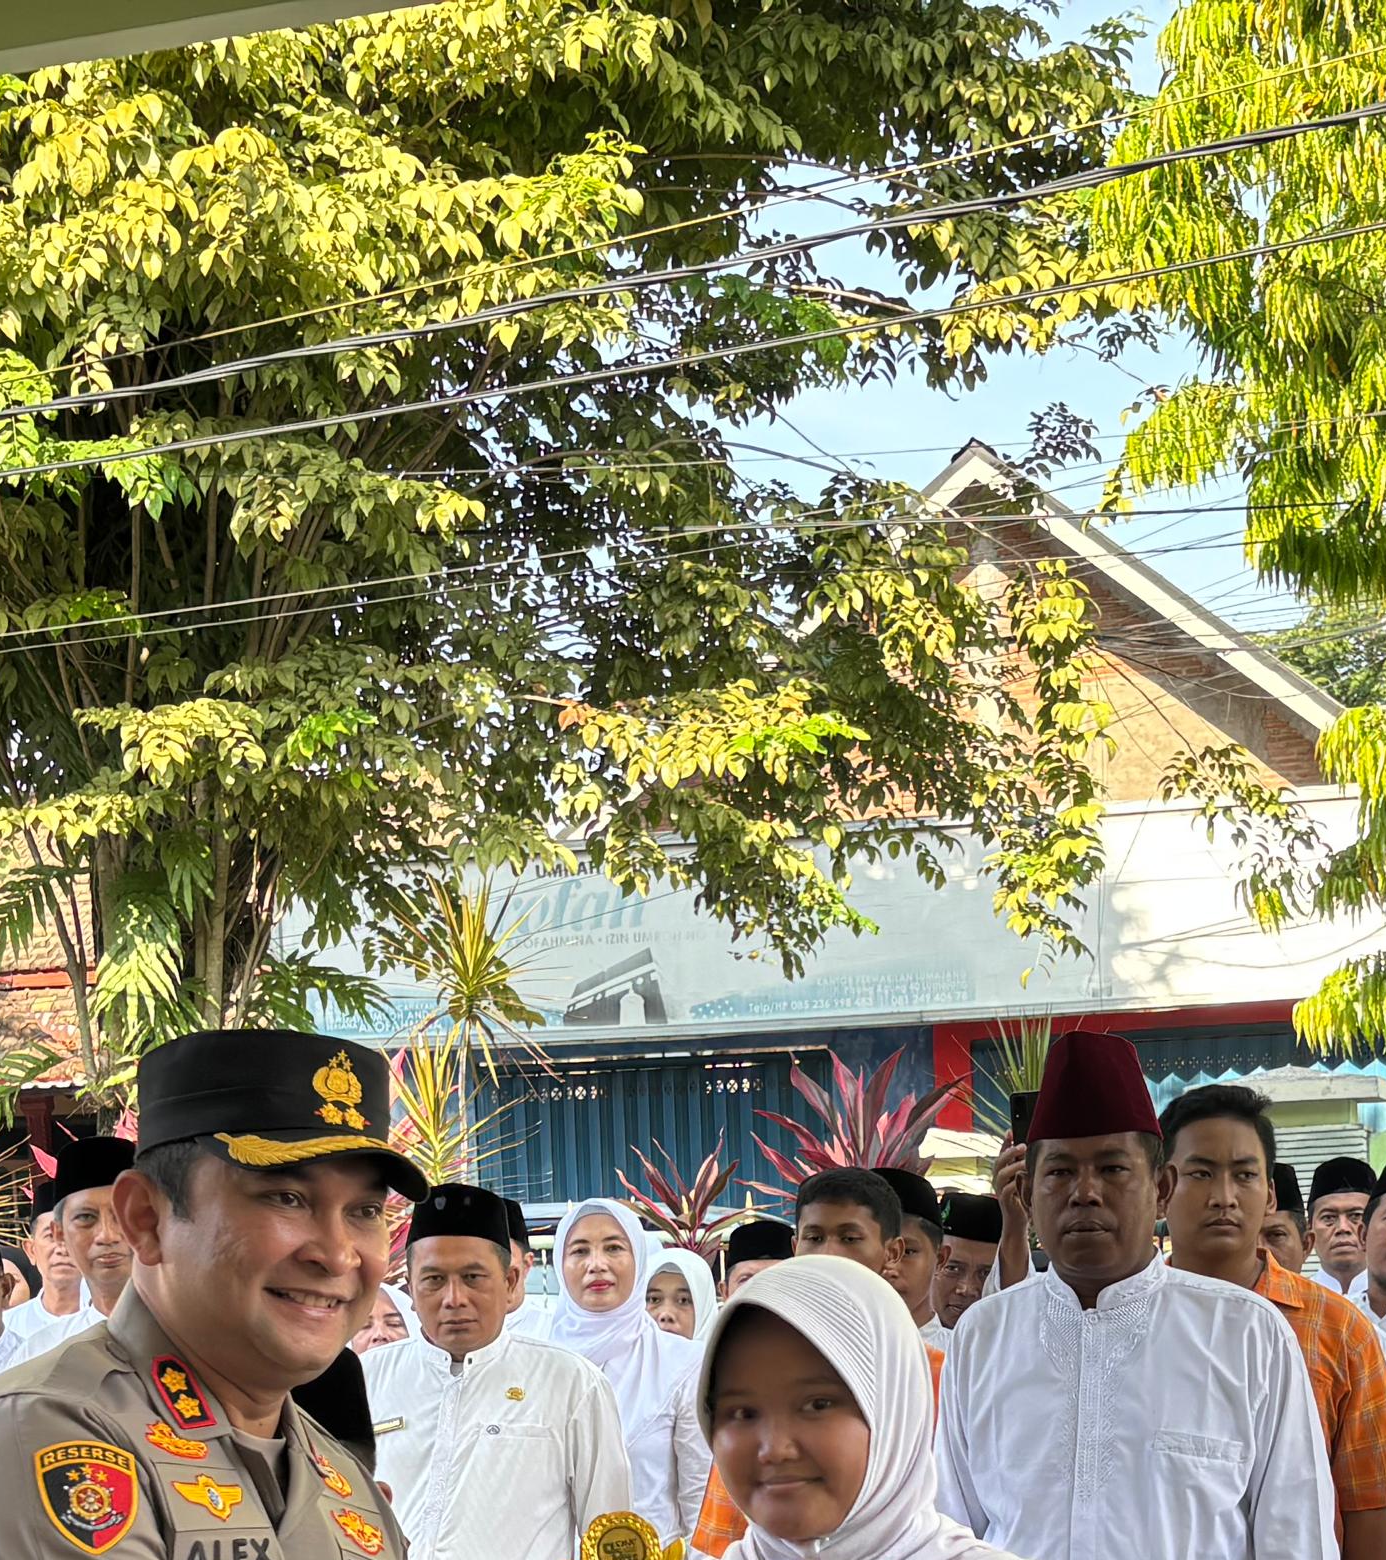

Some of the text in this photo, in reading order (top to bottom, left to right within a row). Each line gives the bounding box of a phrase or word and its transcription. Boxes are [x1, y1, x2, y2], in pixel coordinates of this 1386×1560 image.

[535, 861, 600, 878] UMAH
[813, 999, 830, 1009] 236
[43, 1446, 128, 1468] RESERSE
